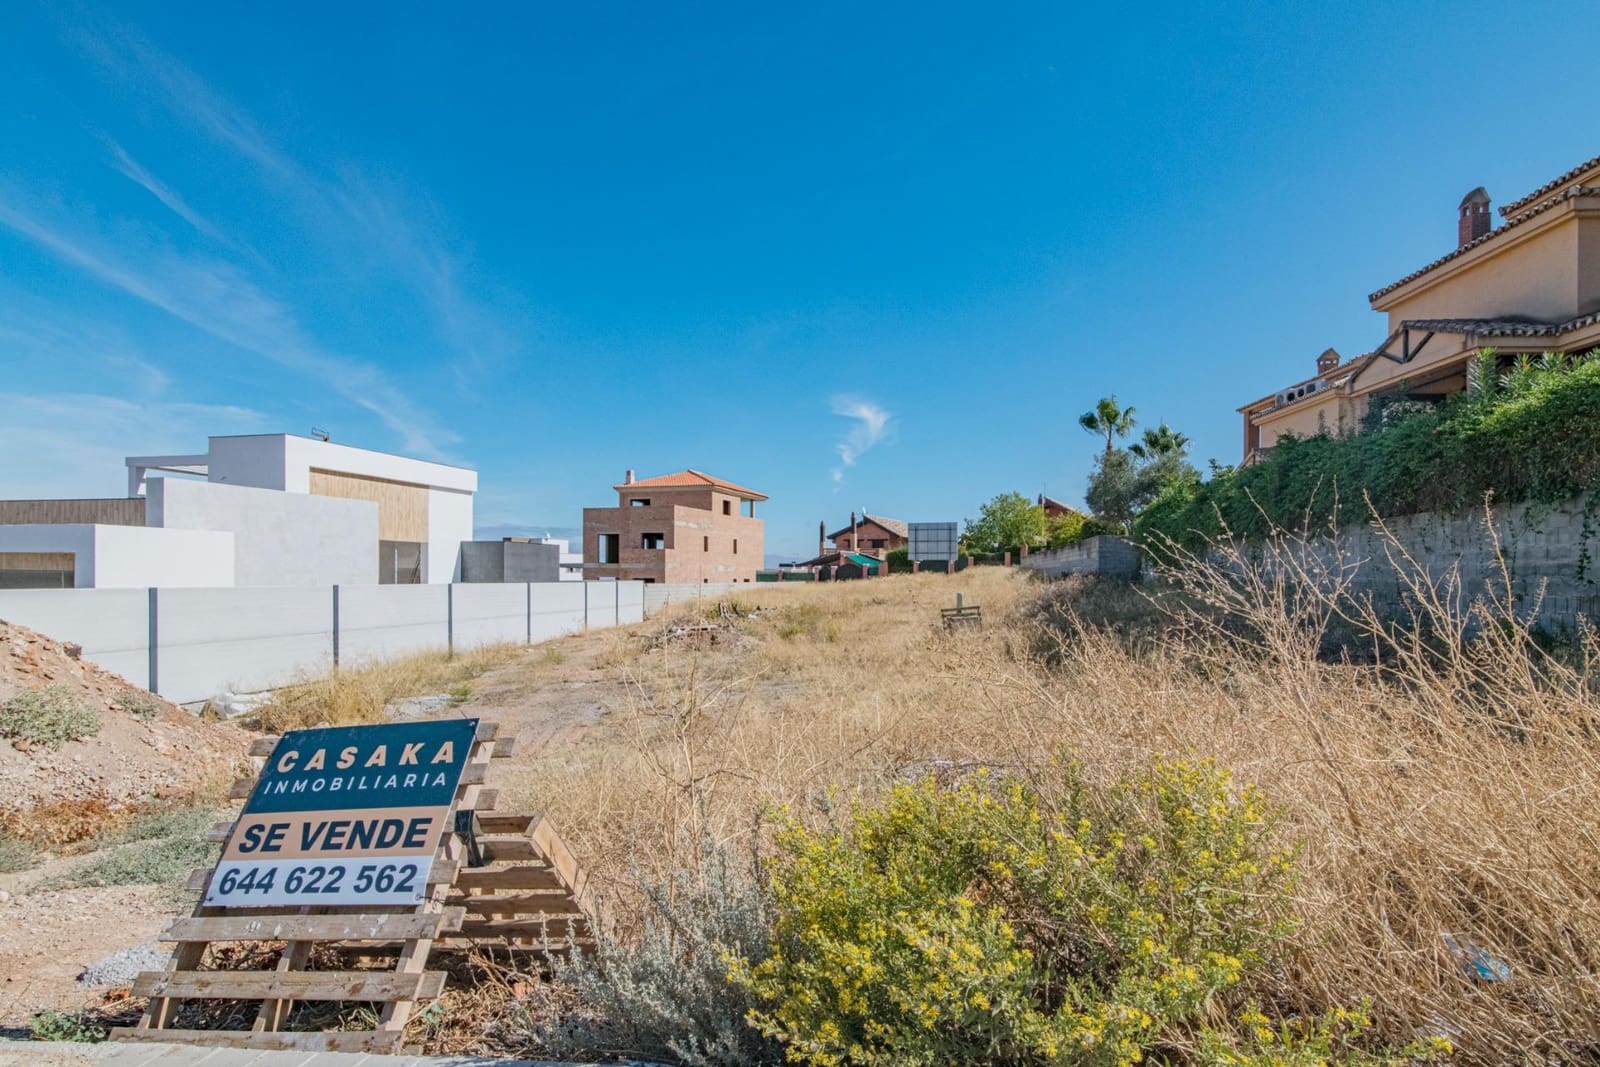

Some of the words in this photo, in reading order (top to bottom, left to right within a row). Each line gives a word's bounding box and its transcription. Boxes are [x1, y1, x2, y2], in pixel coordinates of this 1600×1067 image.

[277, 740, 454, 773] CASAKA
[264, 772, 446, 795] INMOBILIARIA
[238, 823, 290, 853] SE
[300, 817, 433, 851] VENDE
[219, 867, 275, 895] 644
[284, 865, 346, 894] 622
[353, 864, 418, 893] 562
